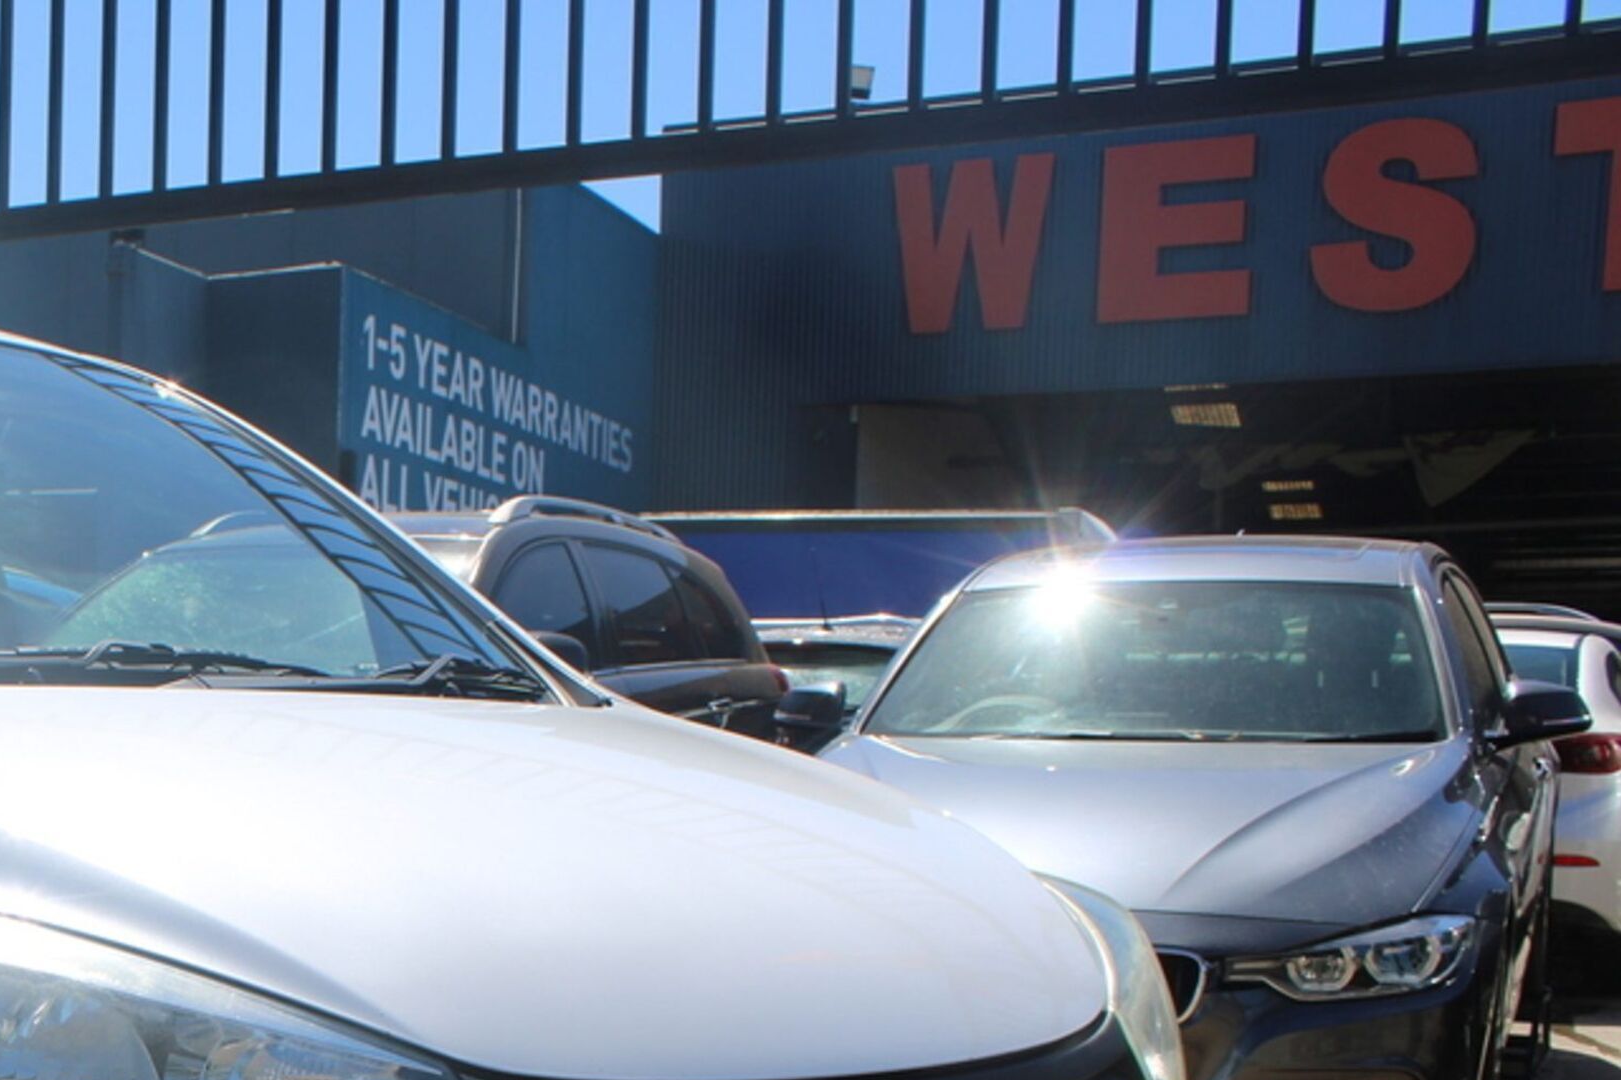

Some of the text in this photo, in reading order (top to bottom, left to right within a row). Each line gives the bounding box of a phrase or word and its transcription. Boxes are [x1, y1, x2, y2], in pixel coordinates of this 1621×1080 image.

[361, 385, 545, 494] AVAILABLE ON
[362, 314, 634, 474] 1-5 YEAR WARRANTIES
[360, 453, 408, 512] ALL
